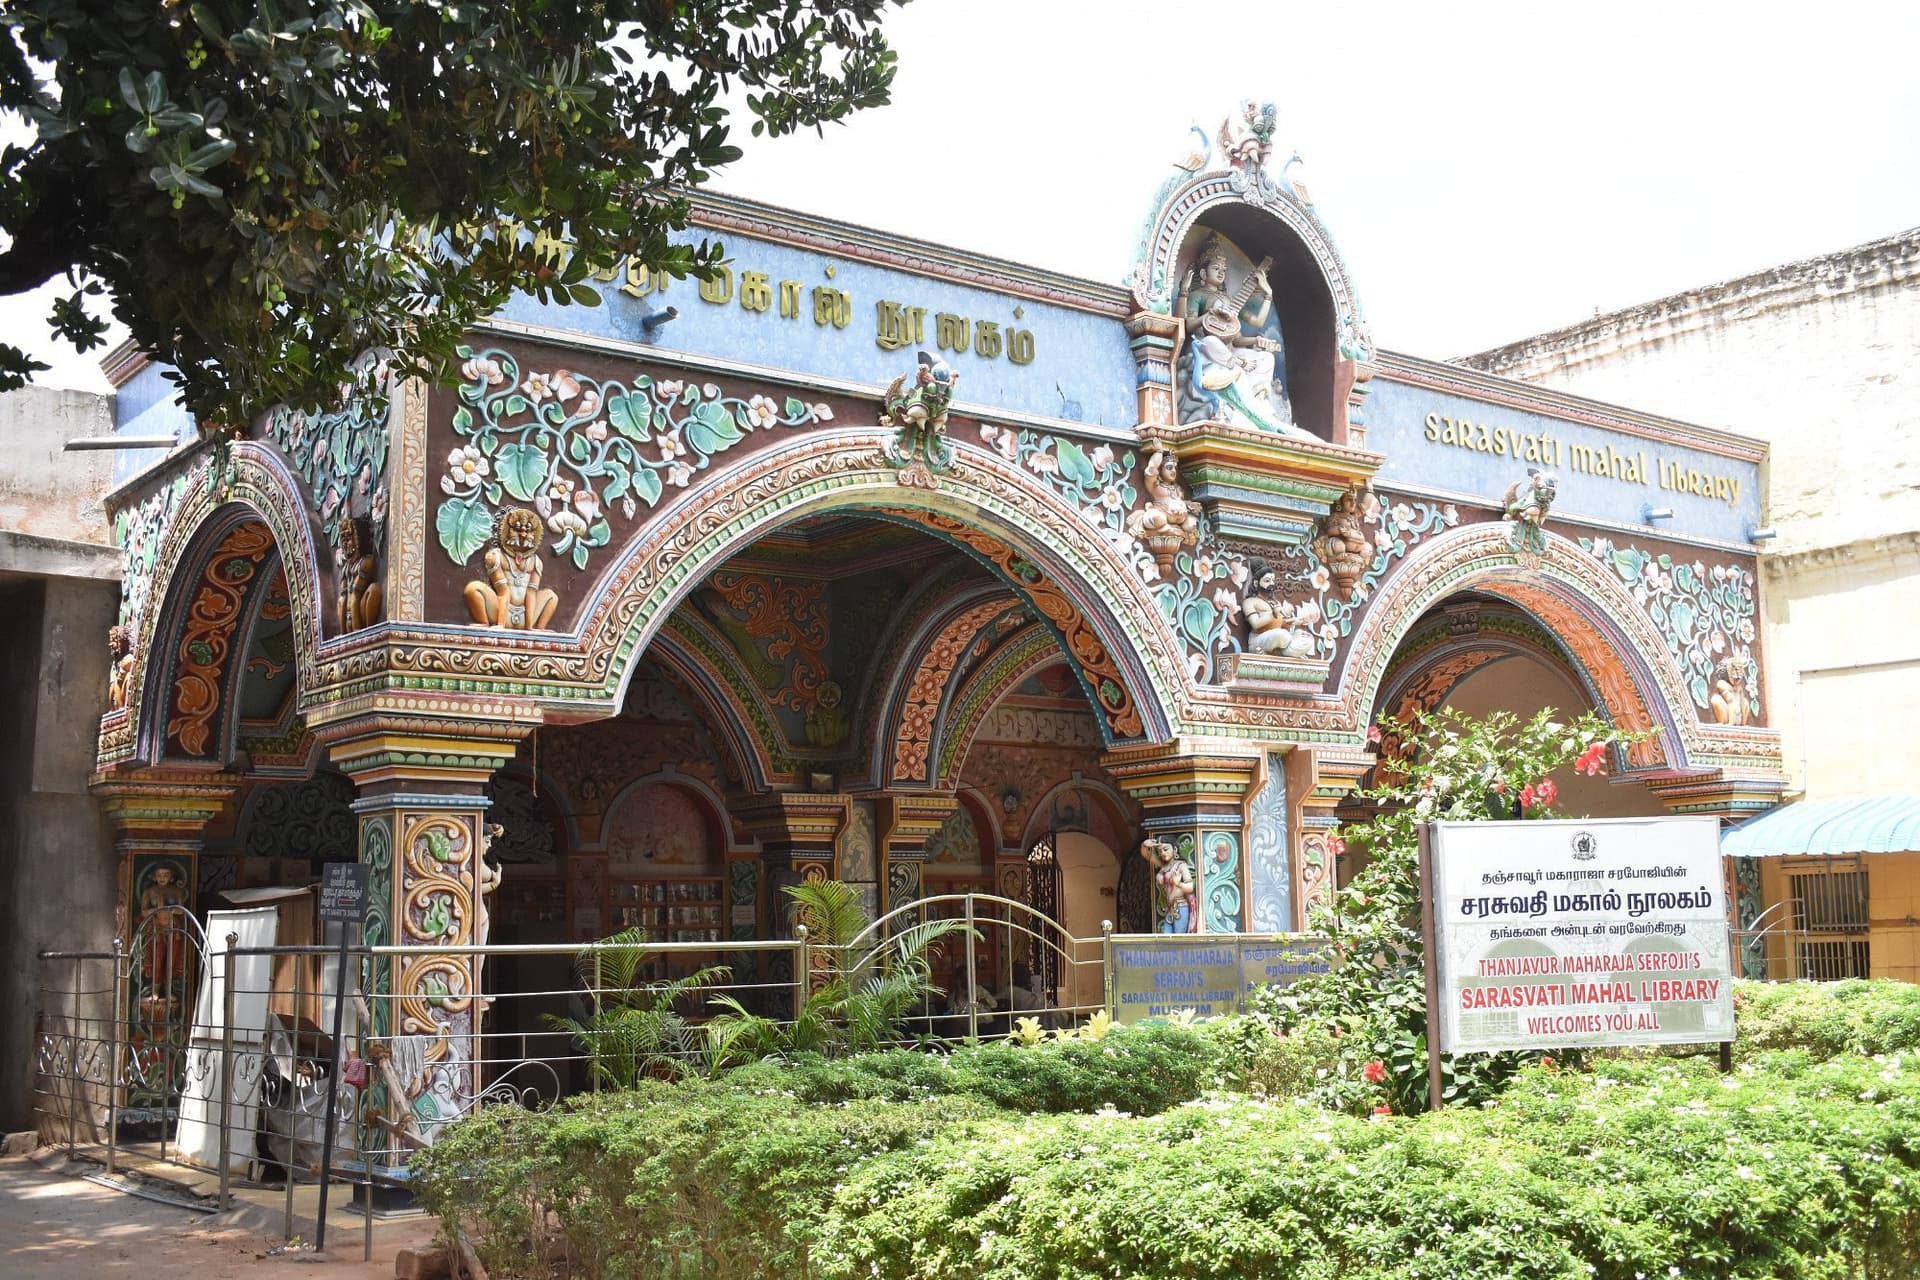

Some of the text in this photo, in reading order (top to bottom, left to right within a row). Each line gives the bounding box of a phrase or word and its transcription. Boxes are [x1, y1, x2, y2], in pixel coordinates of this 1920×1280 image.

[876, 299, 1035, 366] நூலகம்
[1482, 865, 1687, 885] தஞ்சாவூர் மகாராஜா சரபோஜியின்
[1461, 886, 1712, 918] சரசுவதி மகால் நூலகம்
[1490, 921, 1686, 940] தங்களை அன்புடன் வரவேற்கிறது
[1119, 949, 1233, 968] THANJAVUR MAHARAJA
[1479, 952, 1700, 977] THANJAVUR MAHARAJA SERFOJI'S
[1121, 991, 1168, 1004] SARASVATI
[1170, 991, 1199, 1002] MAHAL
[1461, 979, 1720, 1009] SARASVATI MAHAL LIBRARY
[1528, 1013, 1660, 1034] WELCOMES YOU ALL
